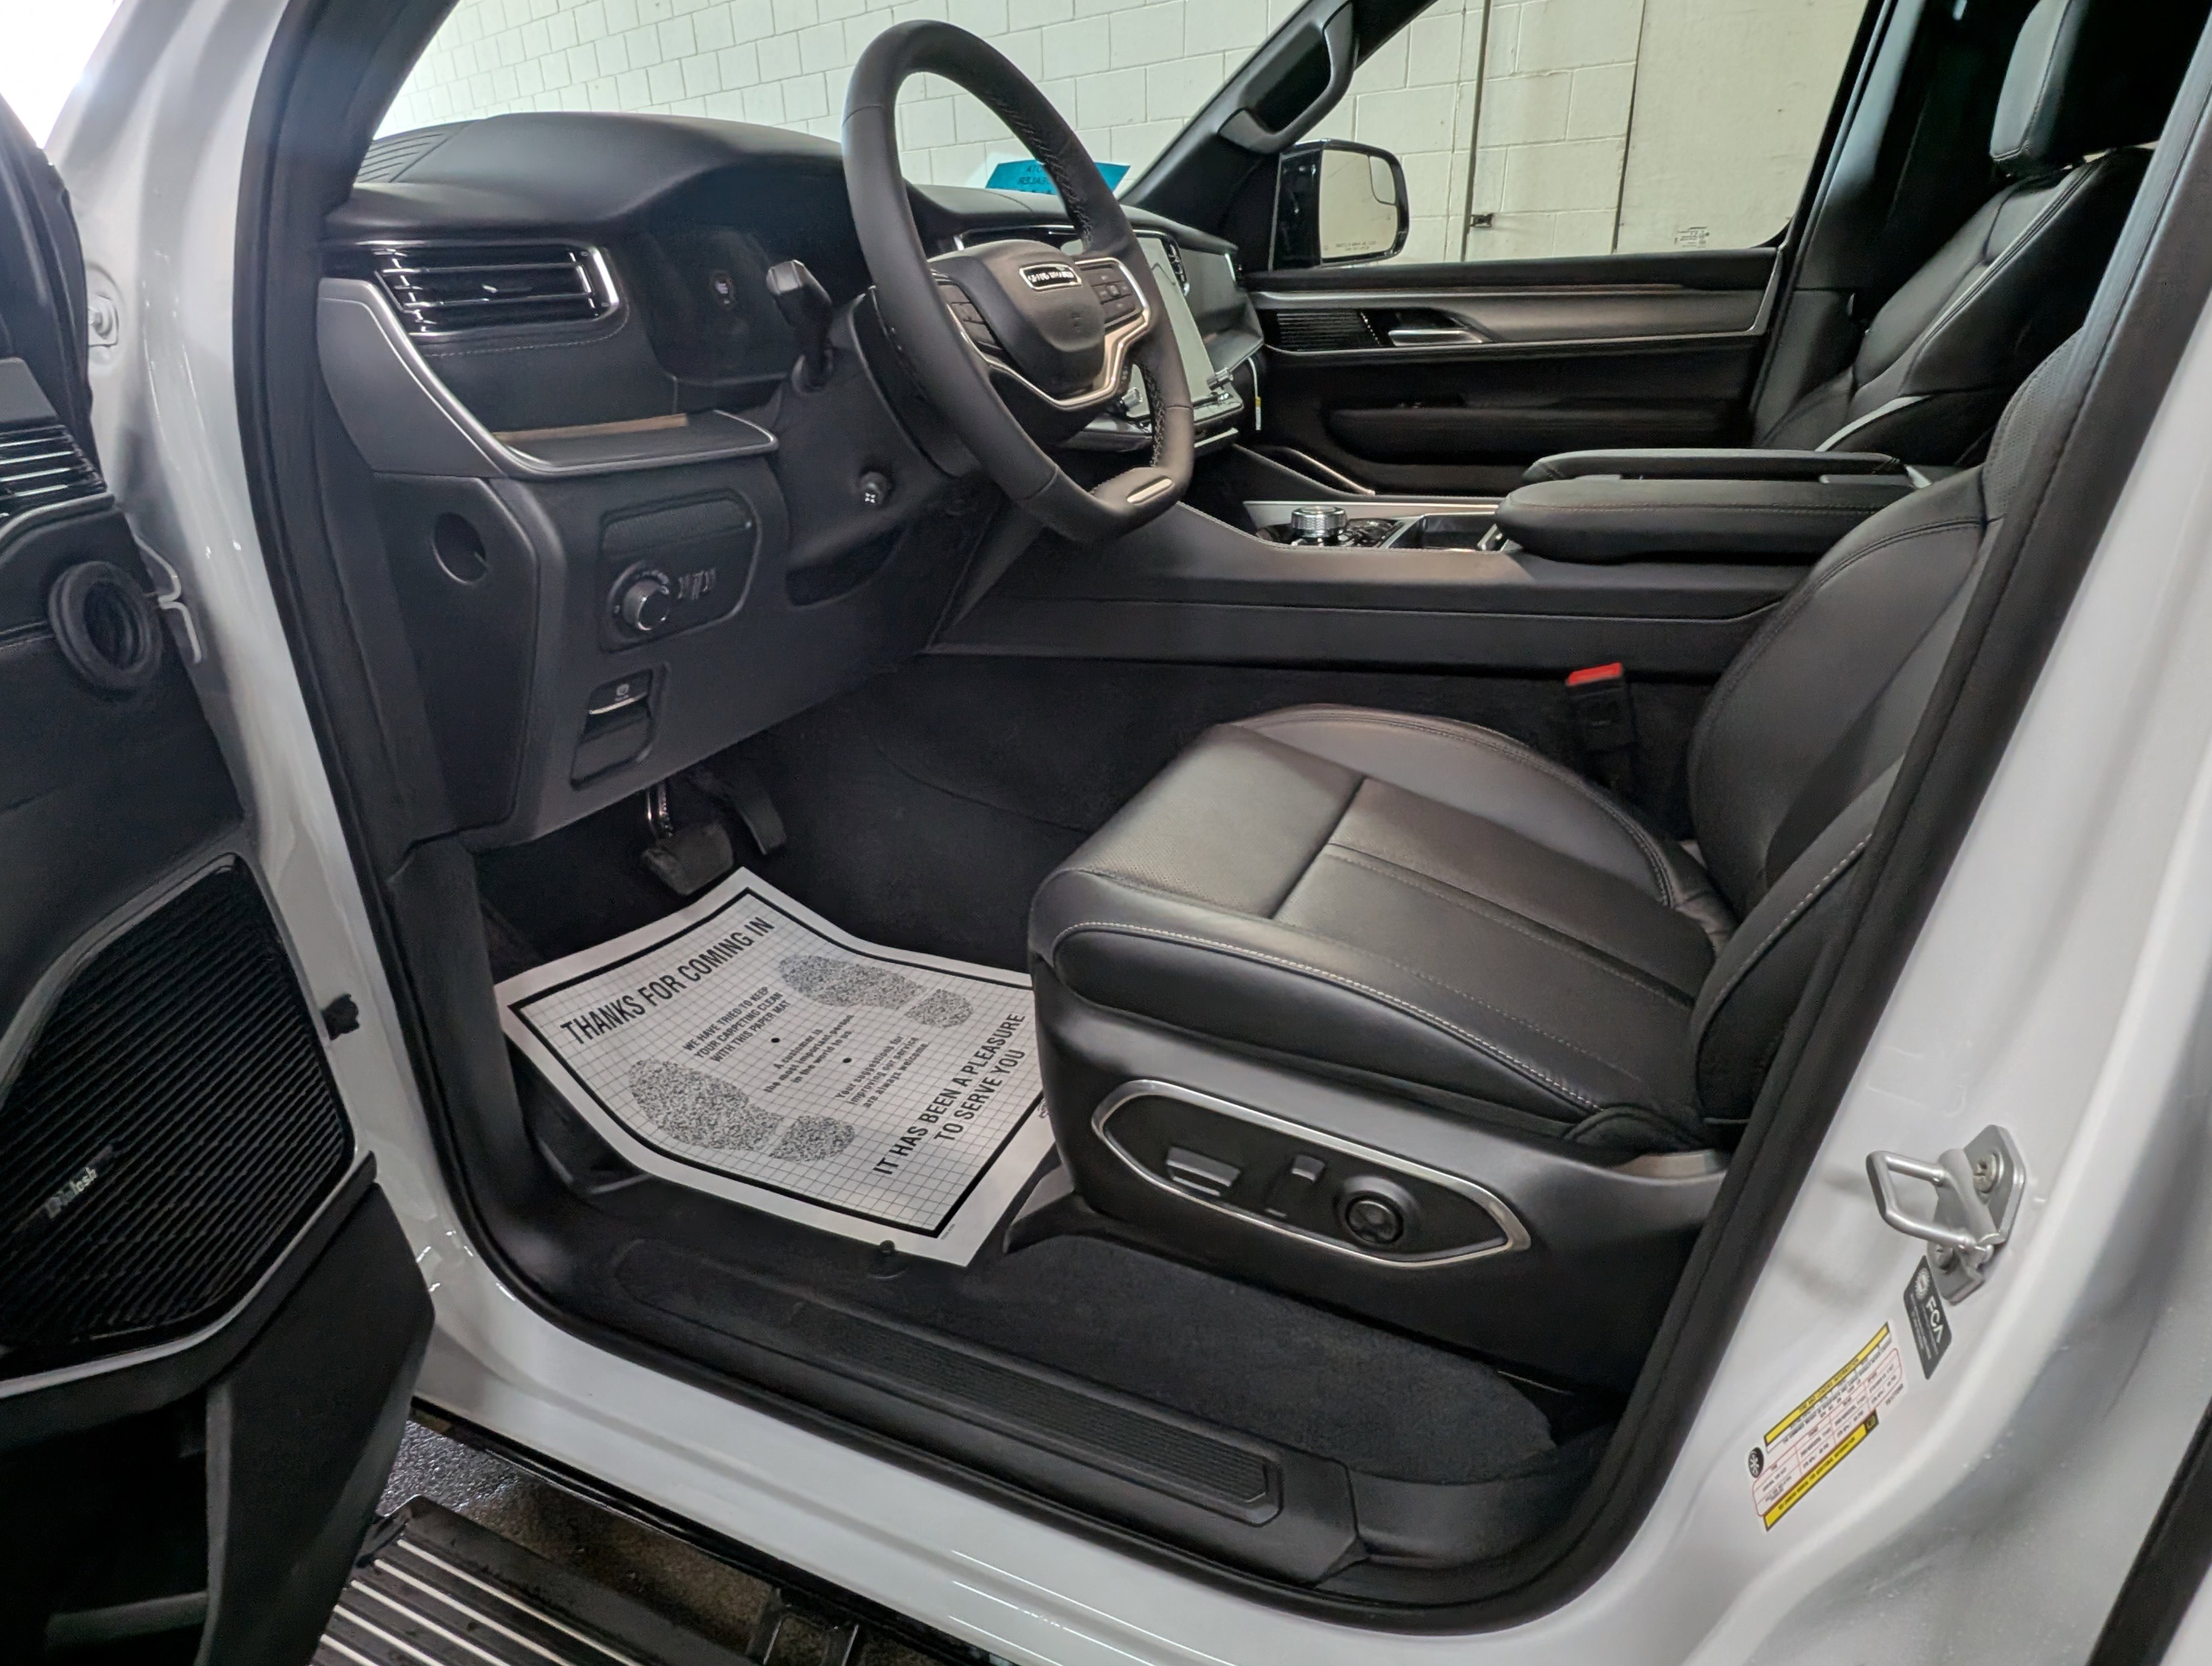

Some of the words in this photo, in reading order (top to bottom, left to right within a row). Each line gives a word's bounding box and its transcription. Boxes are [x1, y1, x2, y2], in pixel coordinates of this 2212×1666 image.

[560, 995, 646, 1044] THANKS
[638, 975, 686, 1007] FOR
[678, 932, 754, 982] COMING
[744, 917, 775, 936] IN
[683, 1039, 700, 1051] WE
[697, 1024, 721, 1042] HAVE
[716, 1008, 742, 1025] TRIED
[738, 999, 753, 1009] TO
[749, 986, 769, 1002] KEEP
[694, 1040, 721, 1058] YOUR
[717, 1009, 761, 1042] CARPETING
[757, 992, 783, 1011] CLEAN
[710, 1044, 736, 1062] WITH
[731, 1030, 754, 1046] THIS
[749, 1012, 776, 1031] PAPER
[772, 999, 791, 1014] MAT
[763, 1081, 781, 1093] the
[779, 1064, 800, 1081] most
[795, 1035, 832, 1063] important
[781, 1035, 815, 1063] customer
[799, 1065, 816, 1075] the
[813, 1046, 835, 1063] world
[834, 1083, 857, 1098] Your
[853, 1046, 895, 1083] suggestions
[890, 1036, 904, 1045] for
[882, 1060, 896, 1071] our
[893, 1037, 919, 1059] service
[961, 1013, 1026, 1075] PLEASURE
[863, 1095, 878, 1107] are
[875, 1072, 902, 1095] always
[918, 1088, 962, 1124] BEEN
[934, 1123, 964, 1140] TO
[953, 1077, 1002, 1120] SERVE
[990, 1049, 1026, 1074] YOU
[951, 1078, 973, 1087] A
[889, 1126, 928, 1157] HAS
[873, 1157, 899, 1175] IT
[1926, 1296, 1944, 1343] FCA
